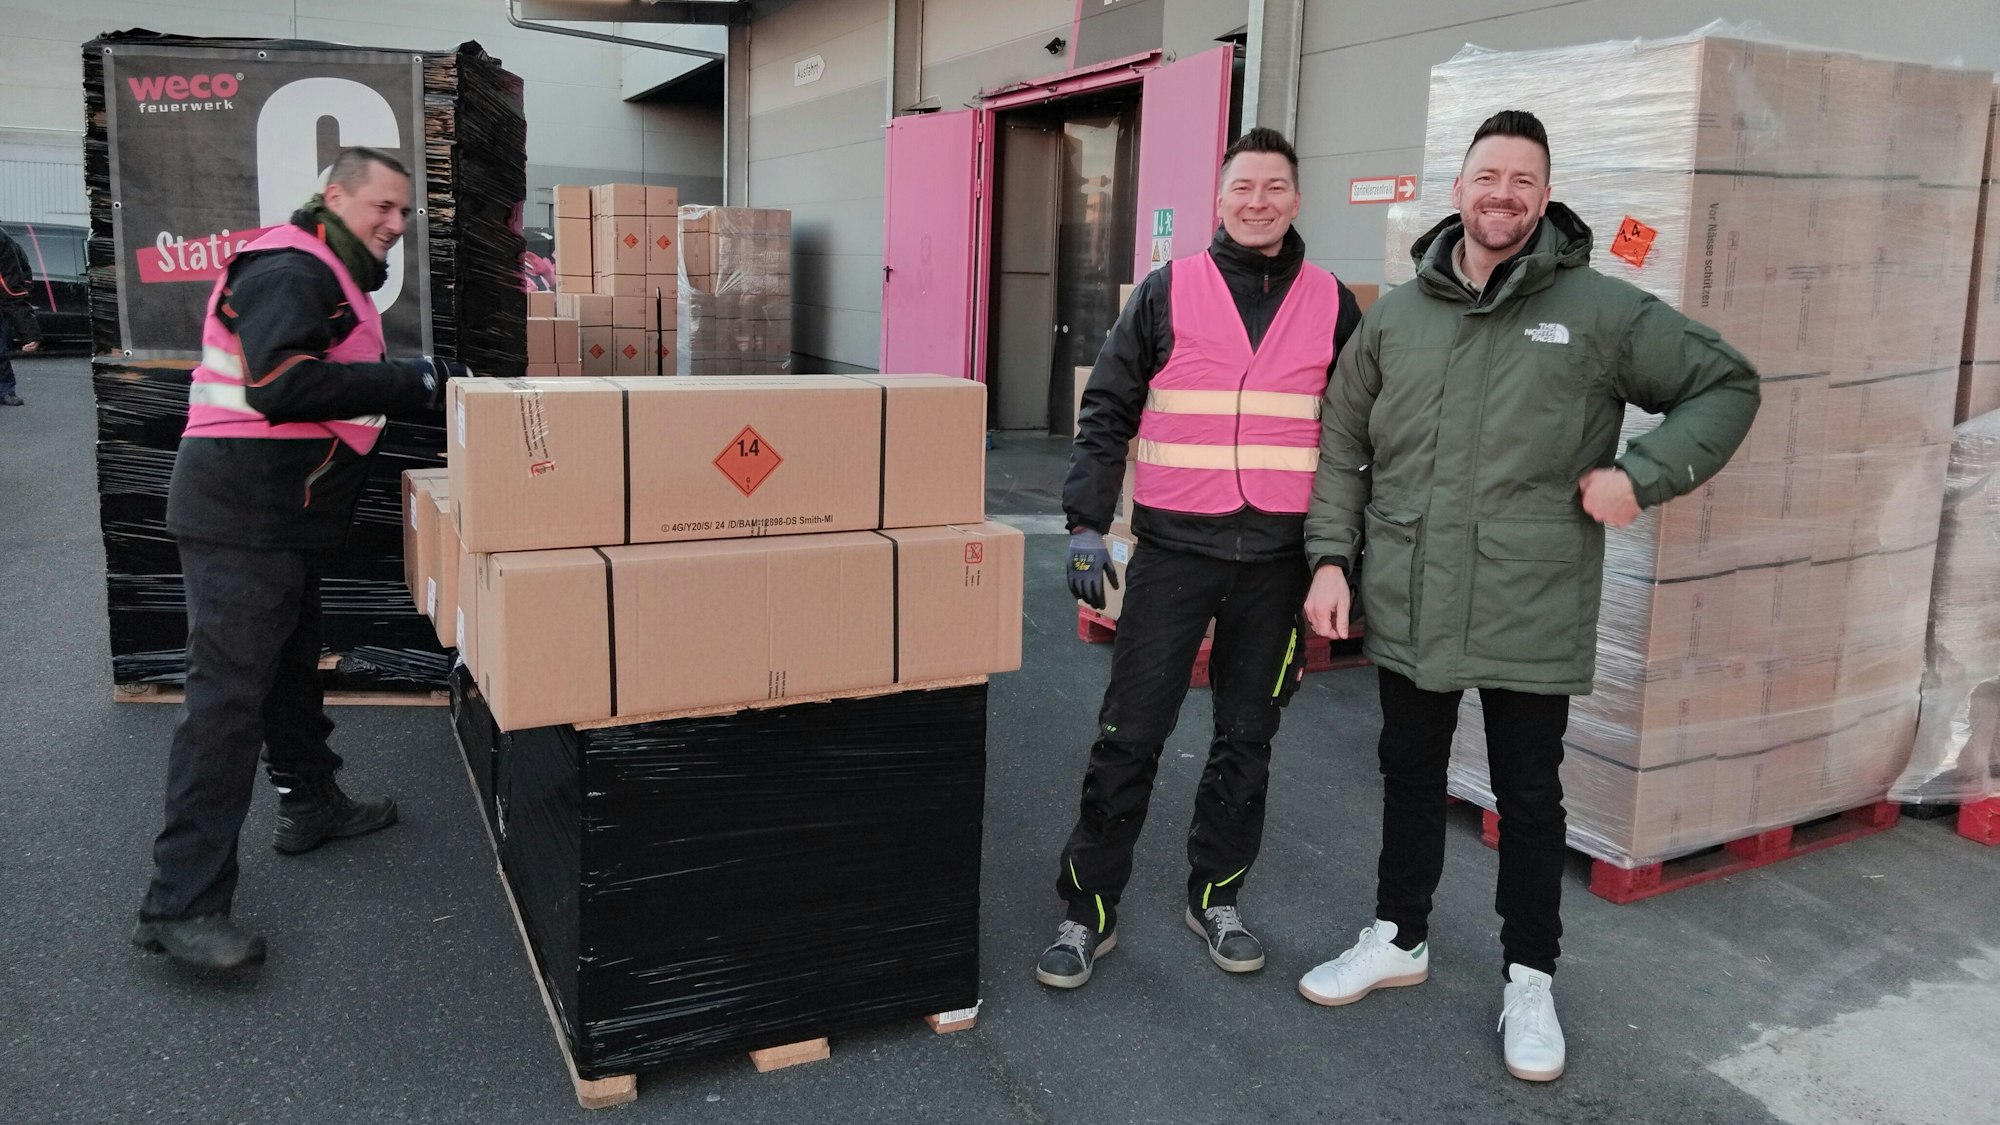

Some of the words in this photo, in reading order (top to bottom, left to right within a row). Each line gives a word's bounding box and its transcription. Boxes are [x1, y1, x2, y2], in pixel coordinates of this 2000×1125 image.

[139, 99, 234, 113] feuerwerk
[1708, 202, 1720, 221] Vor
[1620, 223, 1641, 242] 1.4
[1705, 224, 1718, 257] Nässe
[1701, 259, 1714, 308] schützen
[1523, 328, 1556, 337] NORTH
[1538, 322, 1556, 330] THE
[1531, 335, 1556, 344] FACE
[737, 439, 760, 457] 1.4
[715, 520, 725, 530] 24
